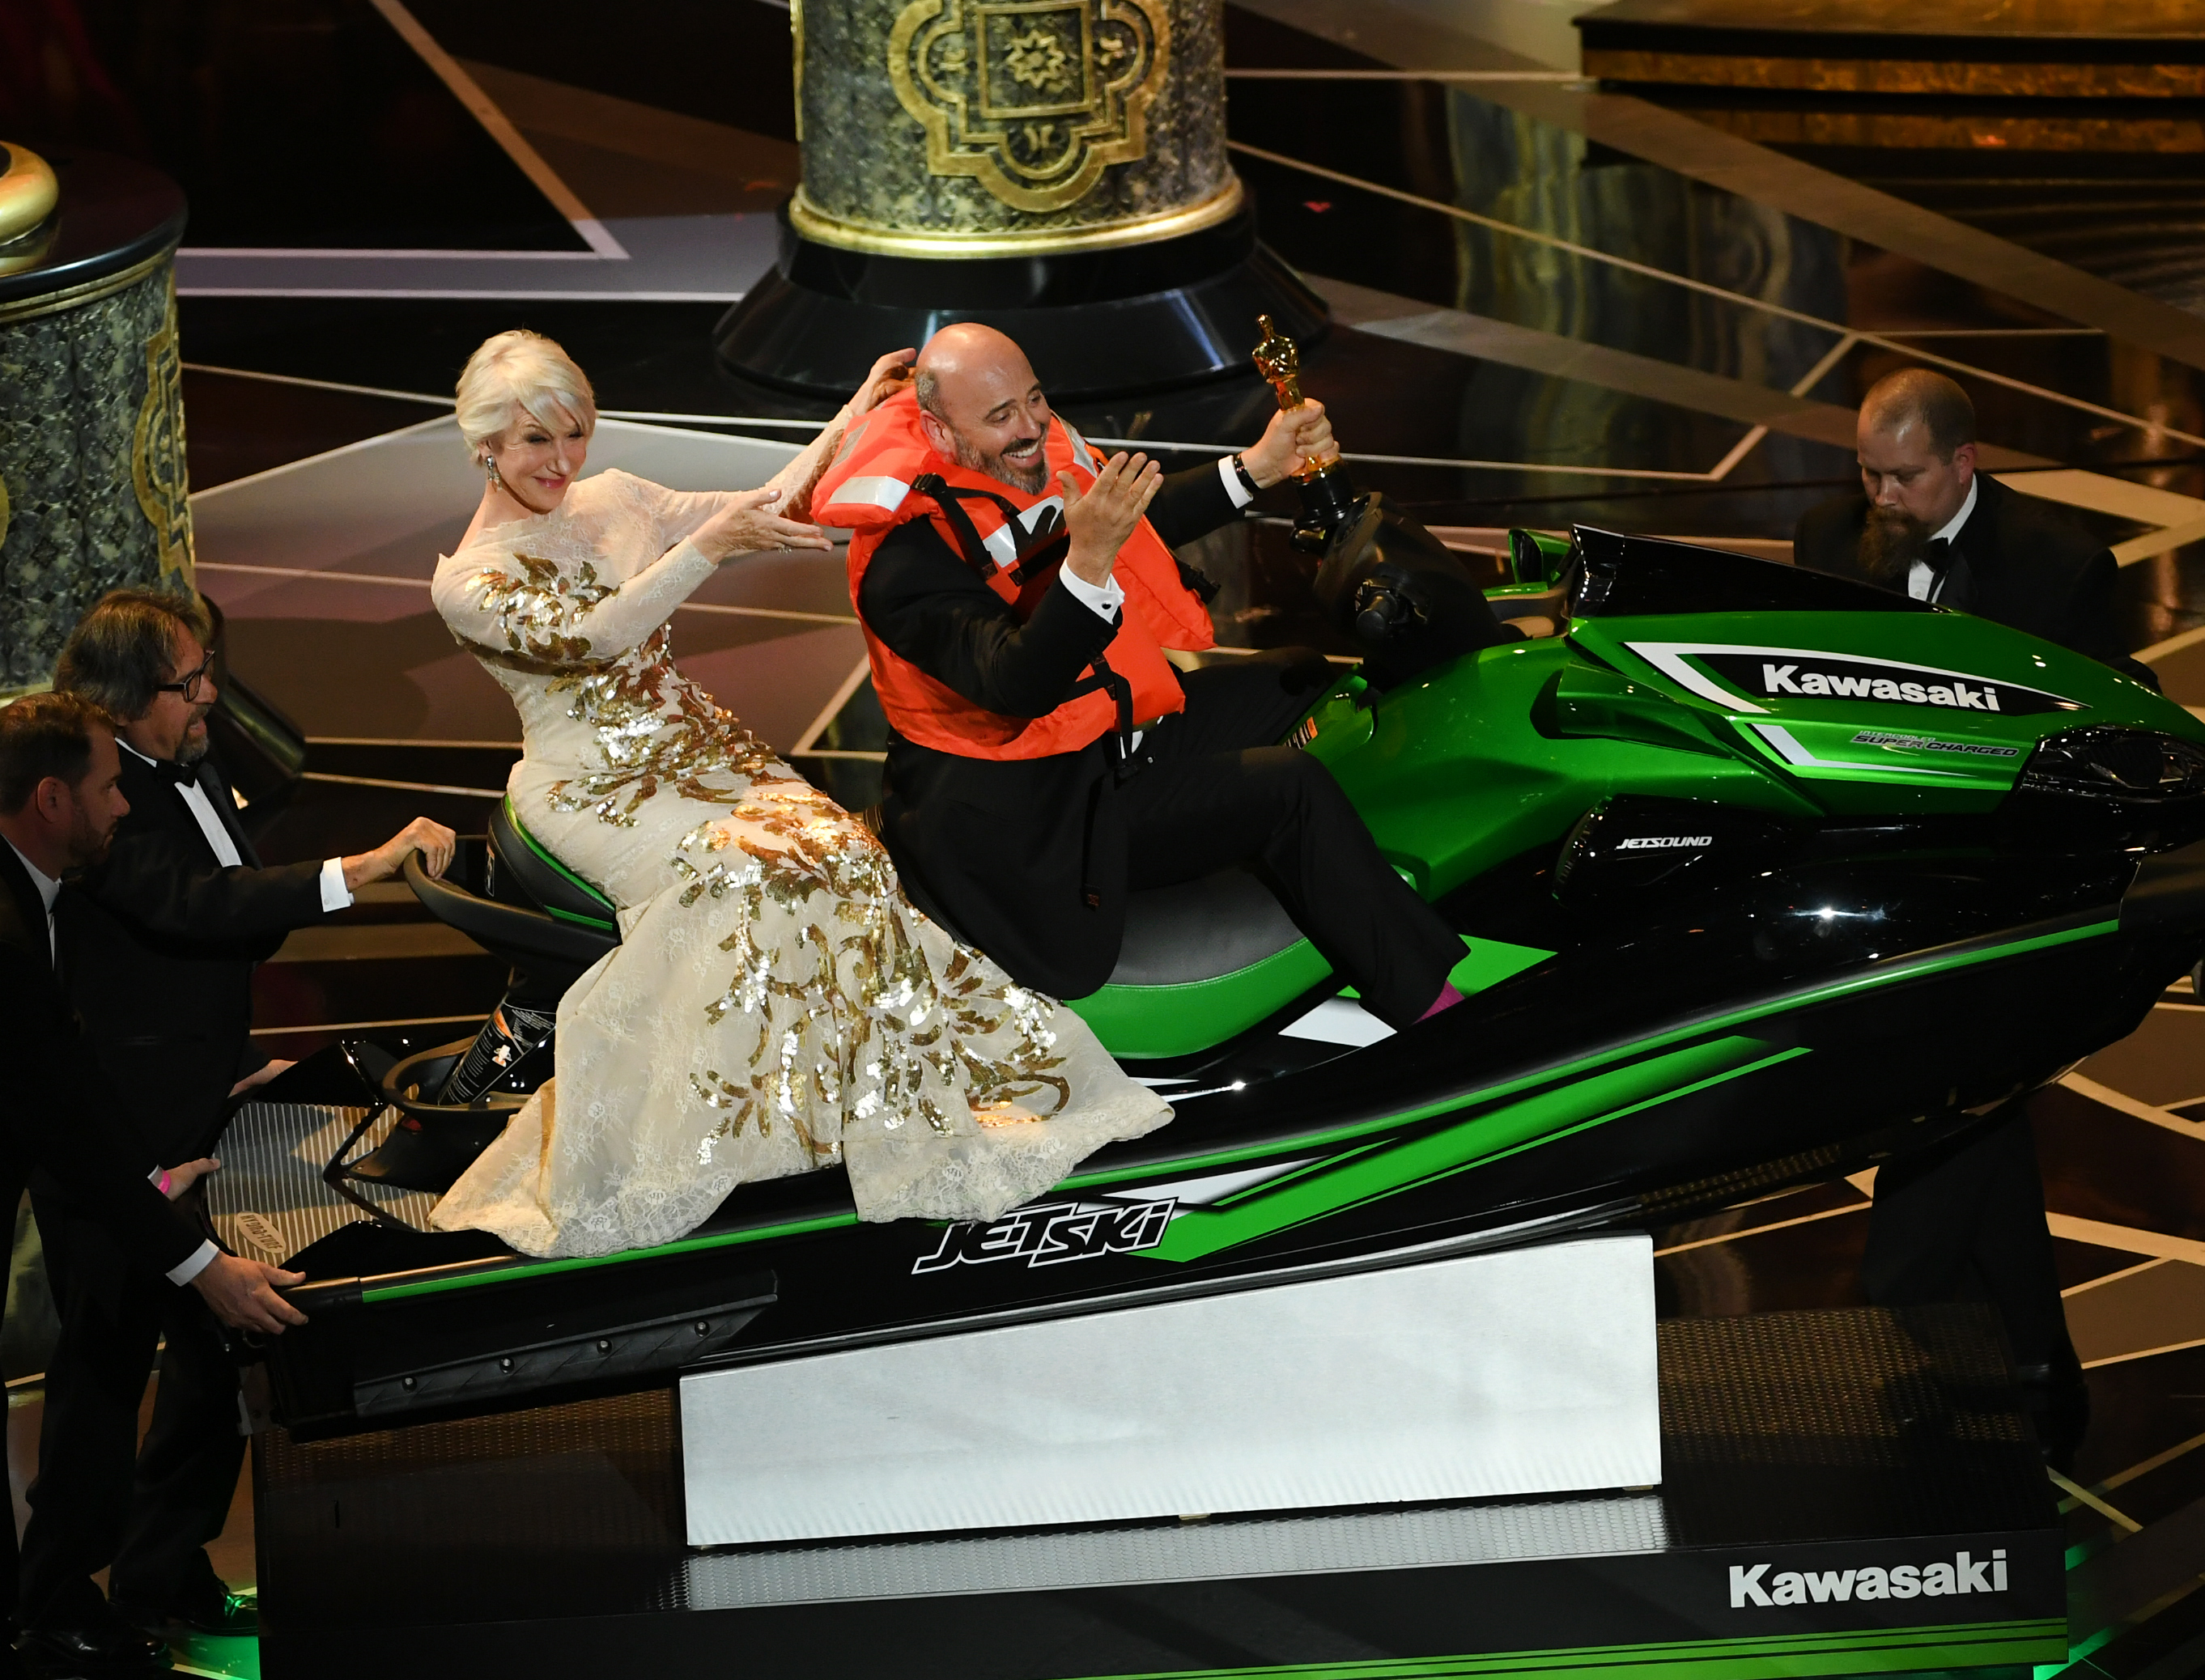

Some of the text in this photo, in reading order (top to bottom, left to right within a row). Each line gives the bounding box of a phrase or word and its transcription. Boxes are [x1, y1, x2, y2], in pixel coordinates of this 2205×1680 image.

[1762, 664, 2000, 711] Kawasaki
[1852, 734, 2020, 757] SUPER CHARGED
[1616, 836, 1713, 850] JETSOUND
[1729, 1549, 2008, 1609] Kawasaki
